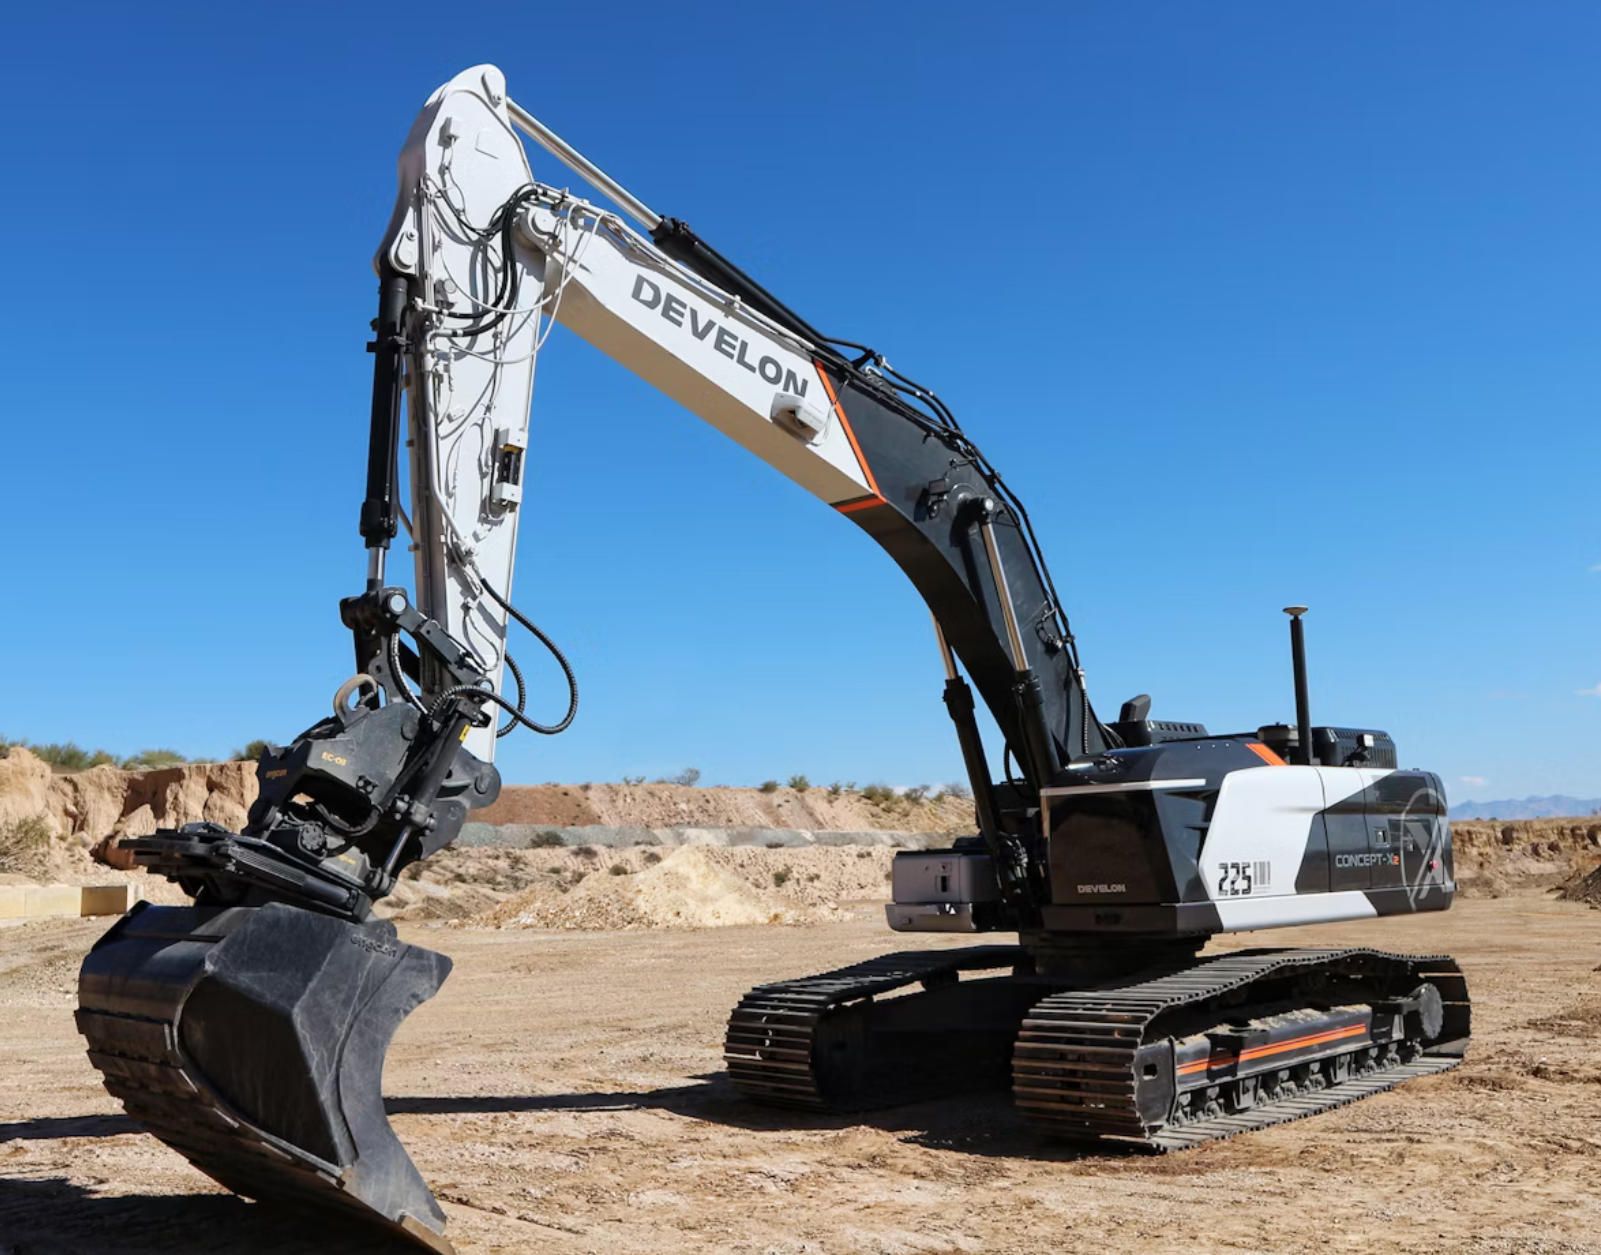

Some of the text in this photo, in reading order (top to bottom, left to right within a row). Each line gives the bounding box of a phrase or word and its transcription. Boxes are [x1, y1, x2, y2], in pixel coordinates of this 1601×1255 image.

[631, 273, 808, 398] DEVELON
[1335, 853, 1400, 868] CONCEPT-X2
[1077, 884, 1126, 893] DEVELON
[1218, 862, 1252, 895] 225
